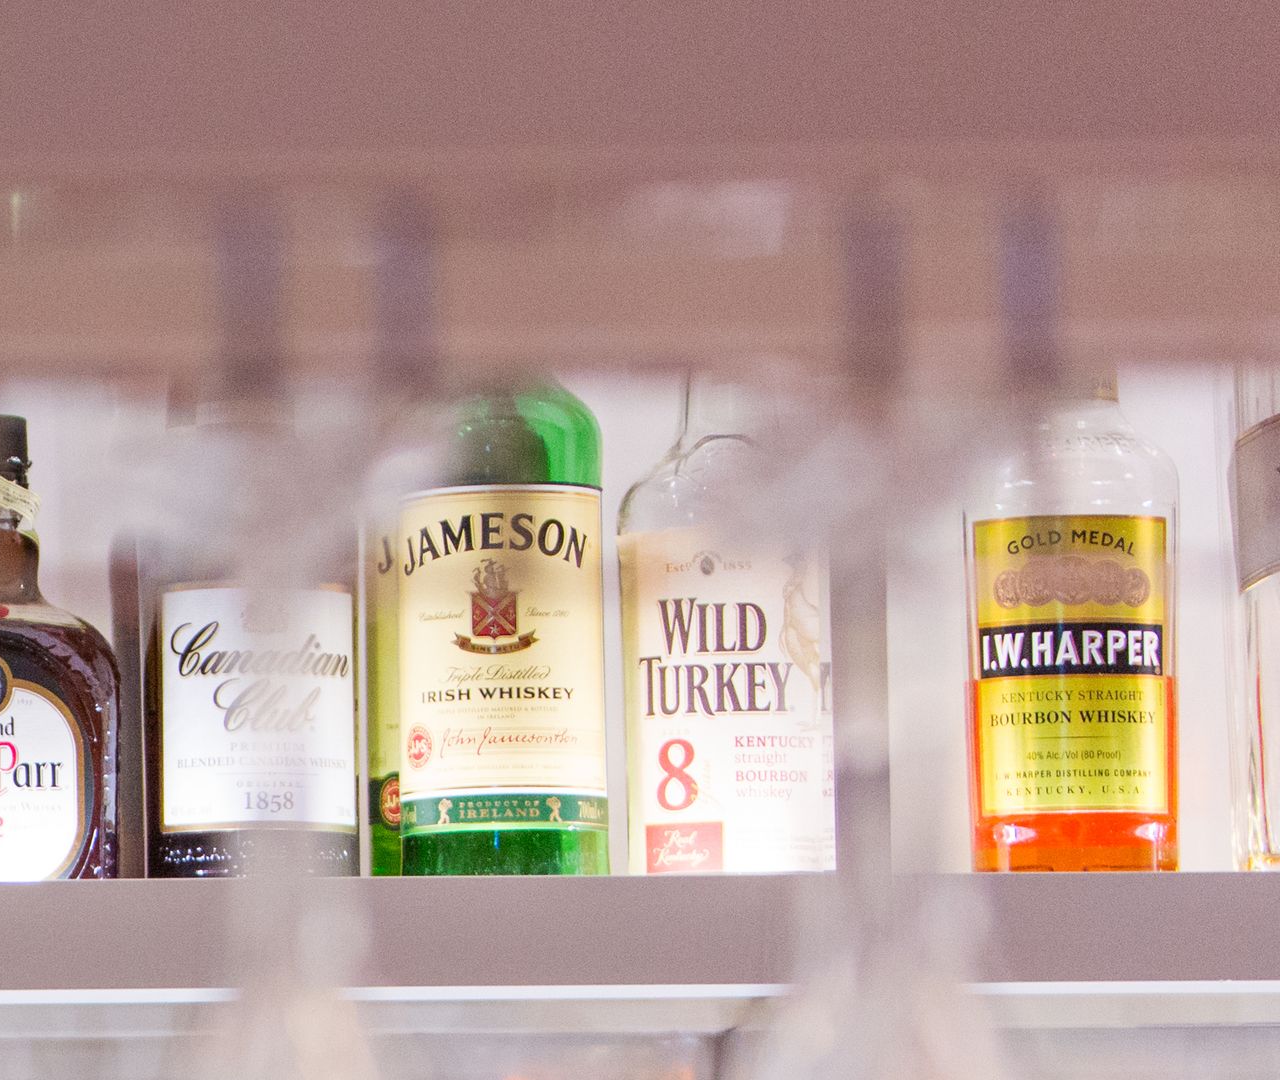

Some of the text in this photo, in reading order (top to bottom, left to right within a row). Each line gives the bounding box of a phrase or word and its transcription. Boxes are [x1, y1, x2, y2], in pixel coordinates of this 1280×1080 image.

[404, 512, 588, 576] JAMESON
[1008, 530, 1135, 556] GOLD MEDAL
[657, 598, 768, 656] WILD
[171, 621, 349, 677] Canadian
[440, 664, 551, 687] Triple Distilled
[422, 687, 575, 703] IRISH WHISKEY
[639, 657, 794, 719] TURKEY
[1001, 690, 1144, 703] KENTUCKY STRAIGHT
[990, 710, 1155, 727] BOURBON WHISKEY
[735, 736, 815, 749] KENTUCKY
[177, 756, 235, 769] BLENDED
[310, 759, 348, 769] WHISKY
[735, 751, 788, 765] straight
[657, 739, 699, 811] 8
[735, 770, 808, 782] BOURBON
[1016, 770, 1052, 779] HARPER
[735, 786, 793, 800] whiskey
[244, 791, 294, 813] 1858
[459, 808, 541, 818] IRELAND
